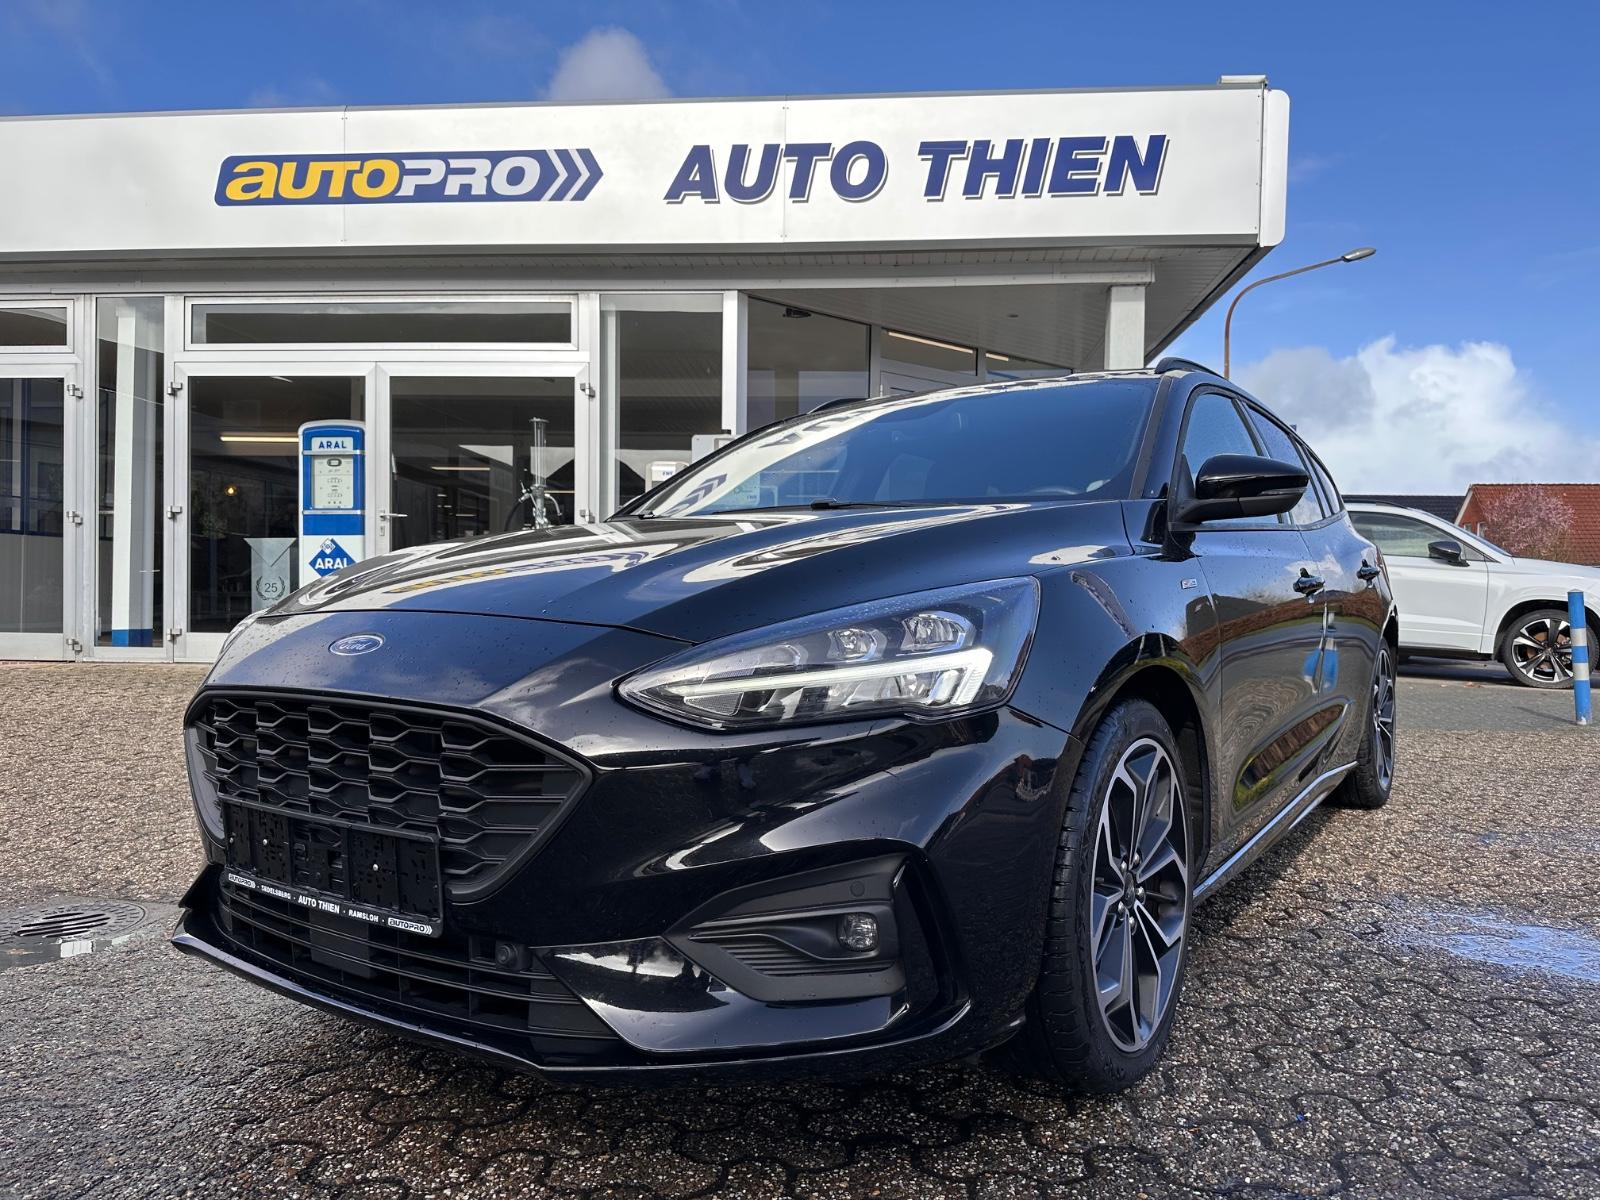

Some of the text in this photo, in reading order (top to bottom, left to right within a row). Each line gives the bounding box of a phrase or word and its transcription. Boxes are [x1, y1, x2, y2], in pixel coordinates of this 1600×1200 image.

[663, 134, 1171, 205] AUTO THIEN
[318, 440, 347, 449] ARAL
[314, 557, 349, 570] ARAL
[264, 582, 278, 593] 25
[298, 895, 317, 907] AUTO
[318, 900, 340, 914] THIEN
[348, 909, 379, 923] RAMSLOH
